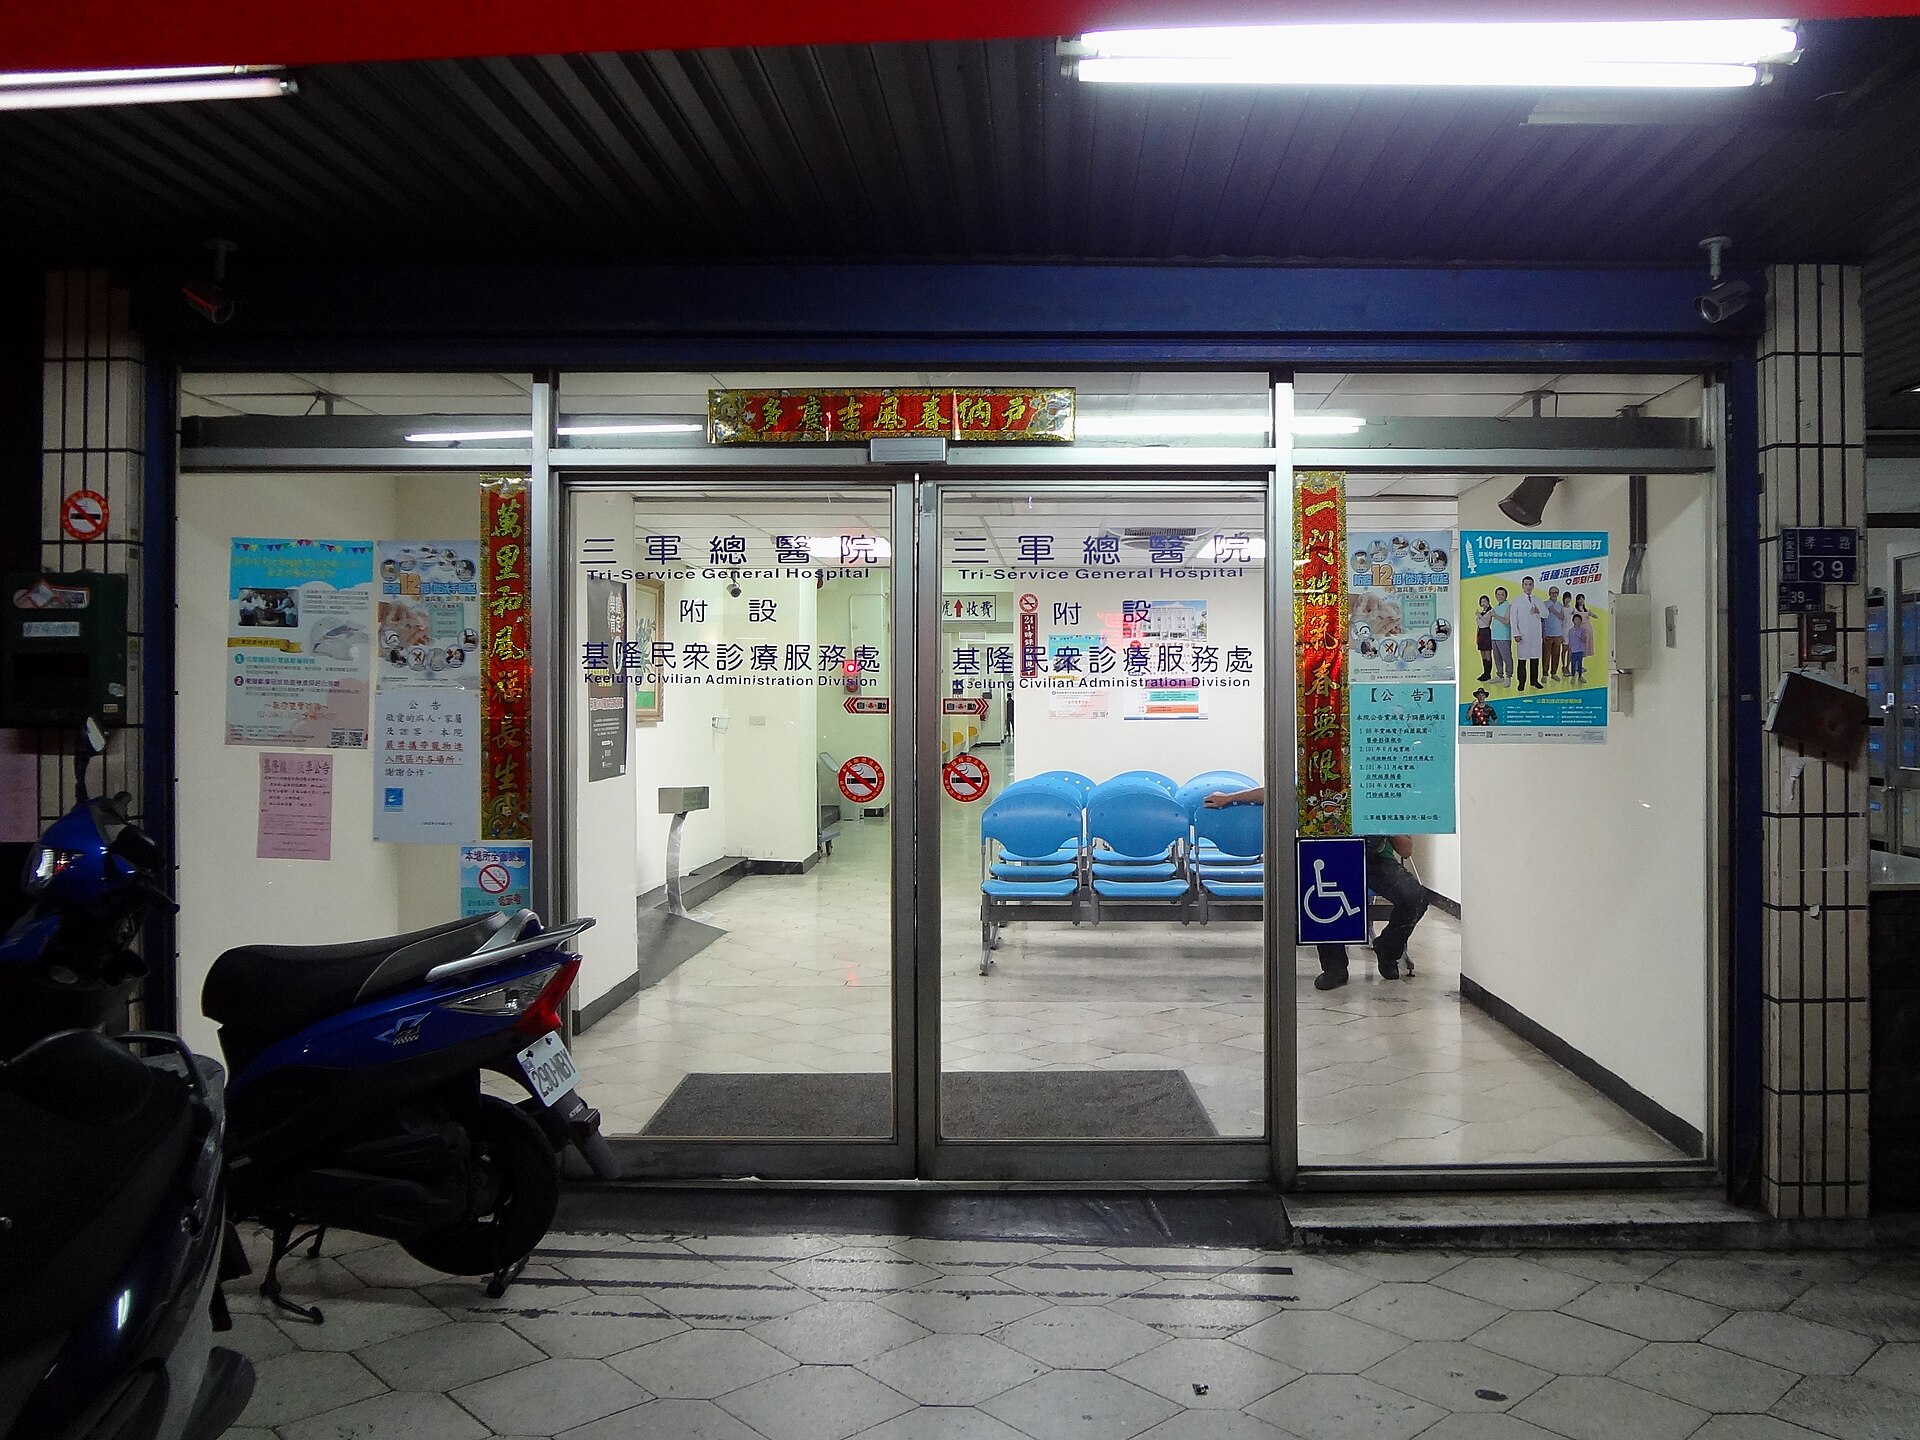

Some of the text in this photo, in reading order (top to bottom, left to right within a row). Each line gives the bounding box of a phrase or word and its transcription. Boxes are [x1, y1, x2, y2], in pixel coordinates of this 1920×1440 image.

[580, 534, 879, 566] 三軍總醫院
[951, 534, 1251, 565] 三軍總醫院
[1804, 535, 1852, 550] 孝二路
[587, 568, 870, 581] Tri-Service General Hospital
[958, 567, 1243, 581] Tri-Service General Hospital
[1811, 560, 1844, 578] 39
[680, 599, 777, 623] 附設
[967, 600, 993, 618] 收費
[1053, 600, 1152, 625] 附設
[584, 673, 643, 686] Keelung
[646, 673, 701, 685] Civilian
[705, 674, 814, 686] Administration
[818, 675, 878, 686] Division
[952, 676, 1251, 691] Keelung Civilian Administration Division
